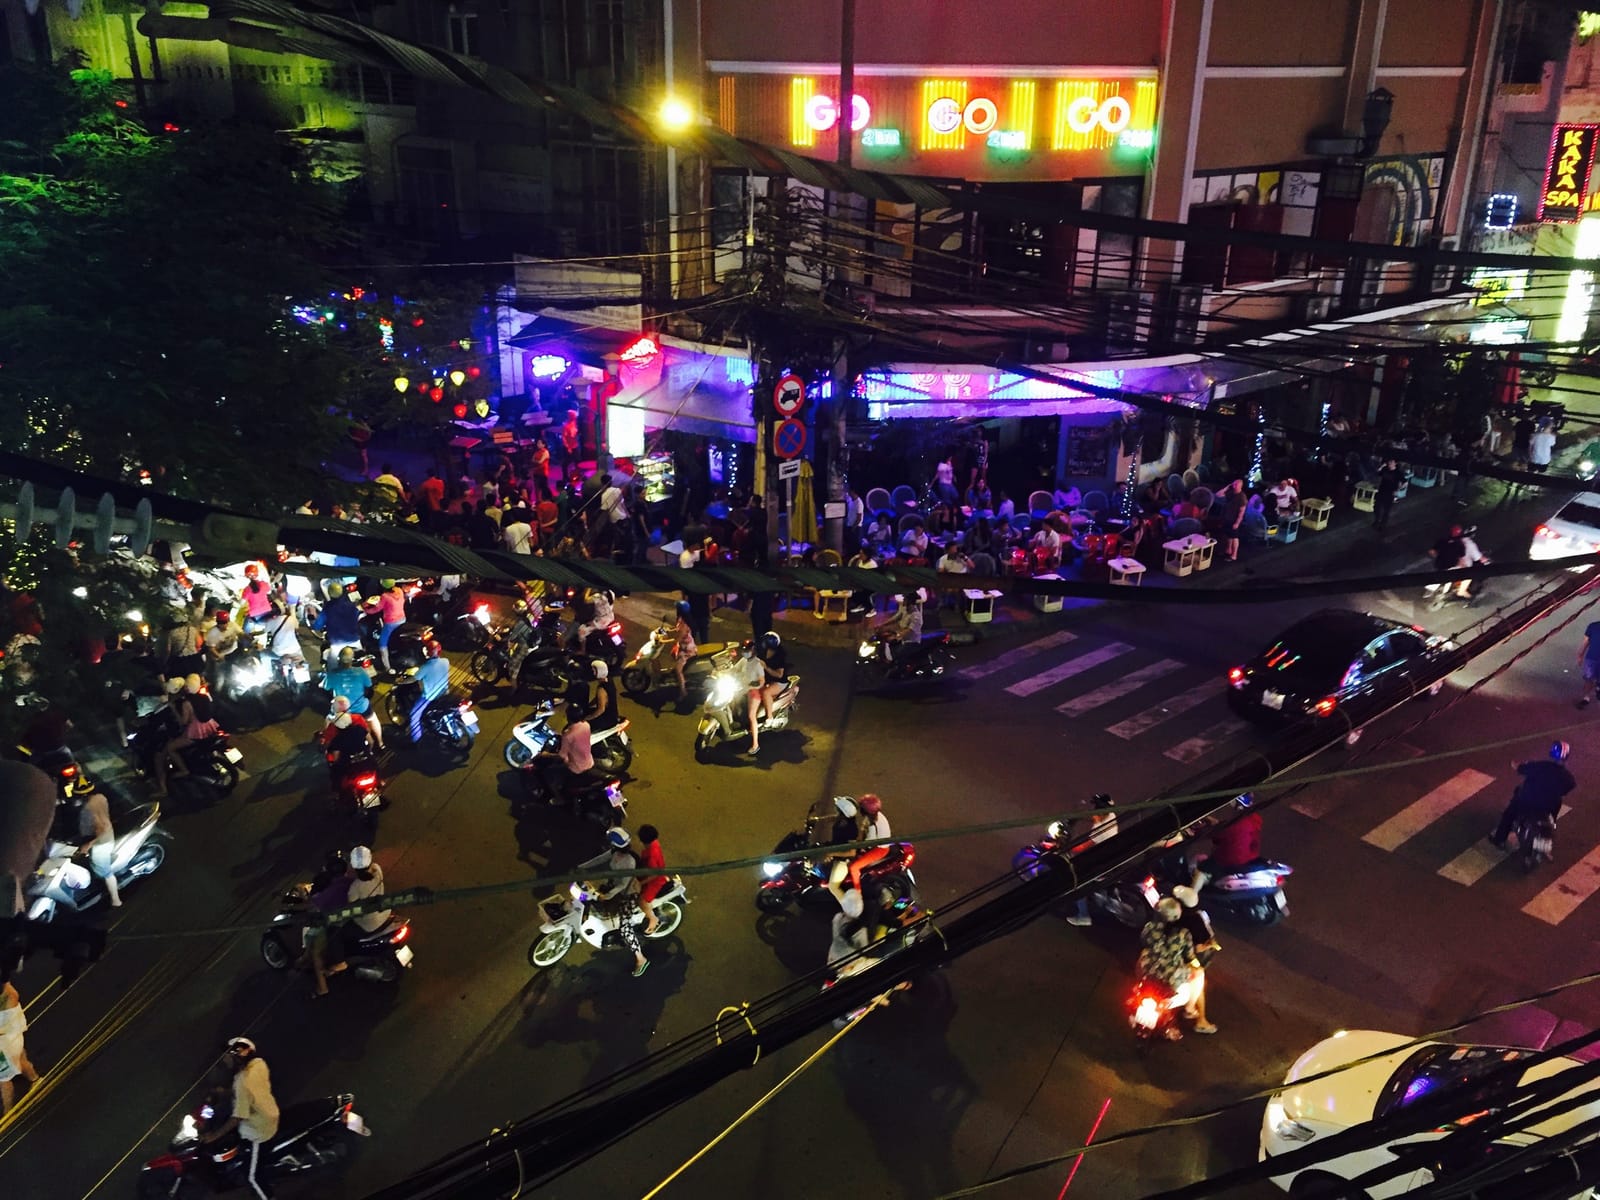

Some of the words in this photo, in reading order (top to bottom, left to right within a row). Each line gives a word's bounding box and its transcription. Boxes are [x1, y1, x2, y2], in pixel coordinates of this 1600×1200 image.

[805, 94, 870, 131] GO
[928, 97, 998, 135] GO
[1067, 96, 1131, 133] GO
[1556, 130, 1584, 189] KAKA
[1544, 190, 1580, 207] SPA
